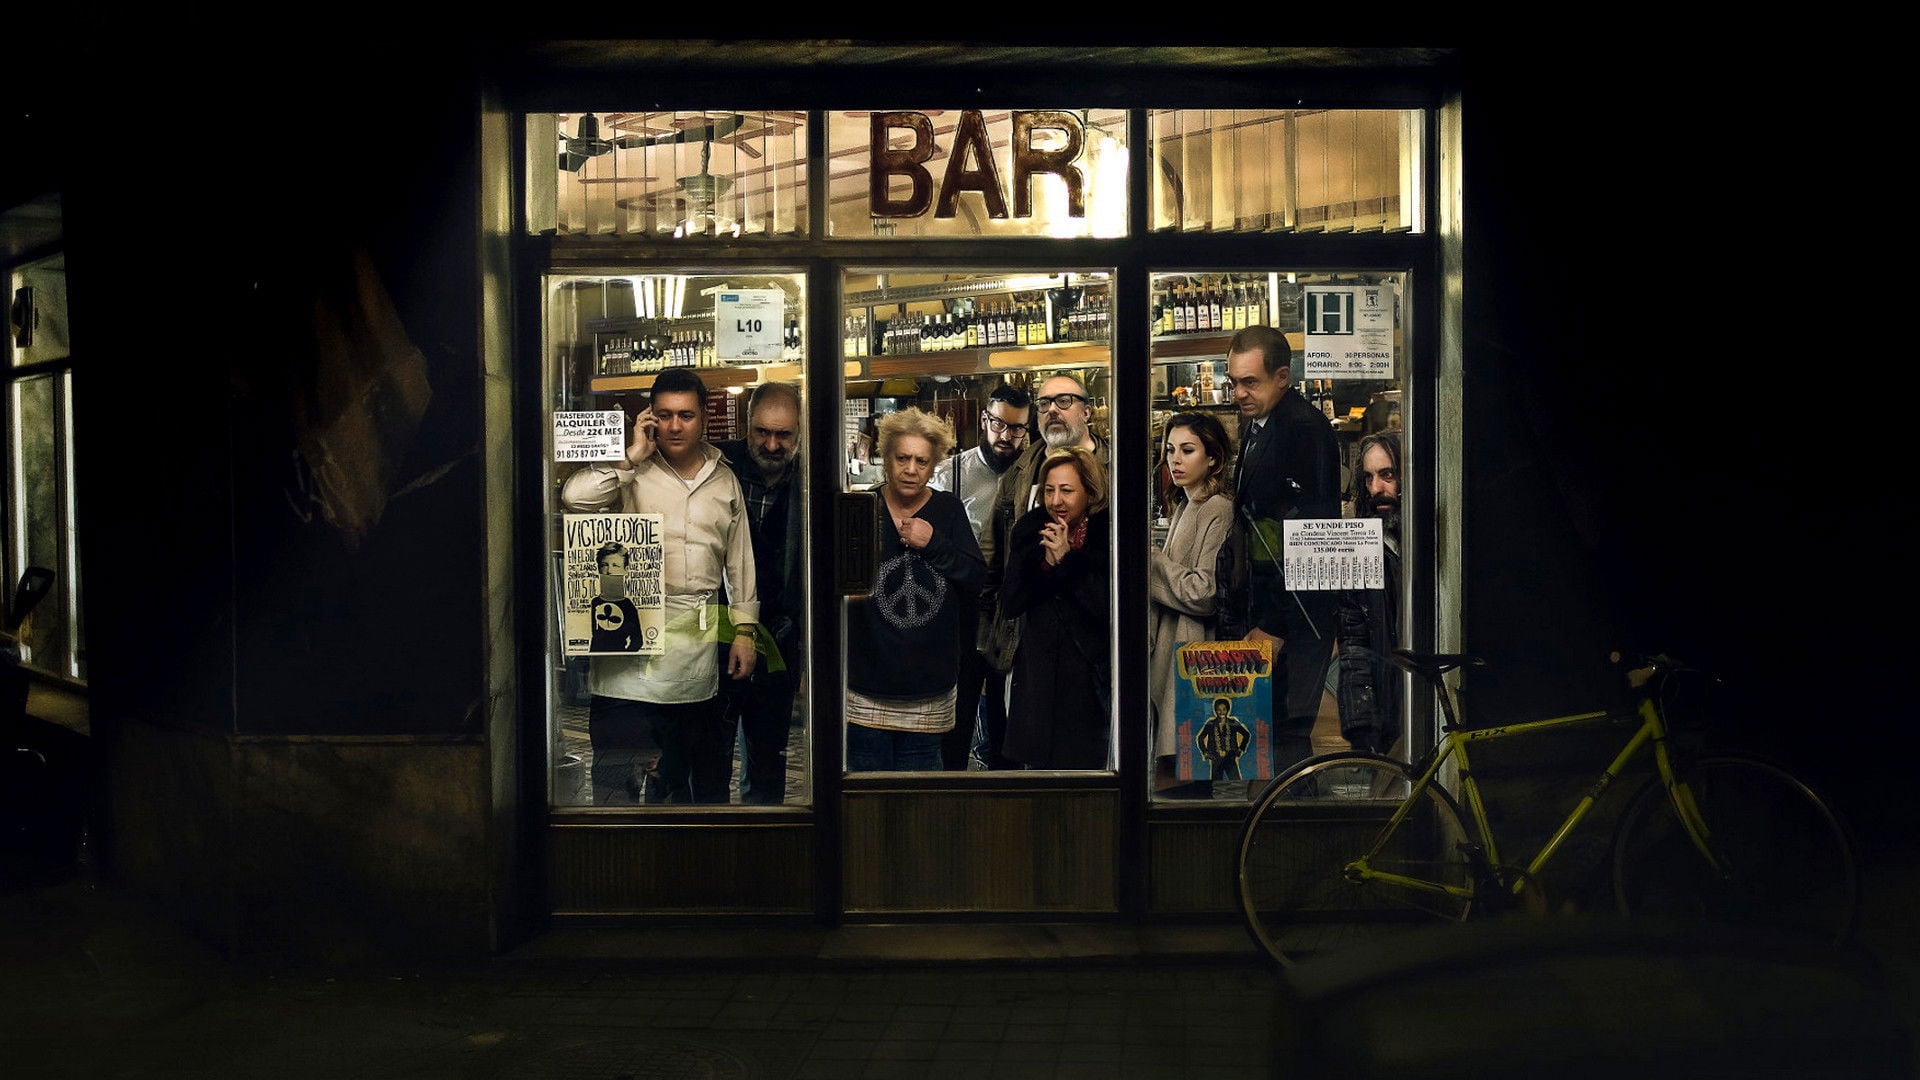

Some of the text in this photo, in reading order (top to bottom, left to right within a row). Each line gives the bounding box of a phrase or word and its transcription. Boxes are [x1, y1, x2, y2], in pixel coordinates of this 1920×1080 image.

[870, 110, 1085, 219] BAR
[737, 320, 762, 333] L10
[1311, 293, 1352, 334] H
[556, 450, 564, 458] 91
[566, 450, 579, 458] 875
[567, 517, 660, 548] VICTOR COYOTE
